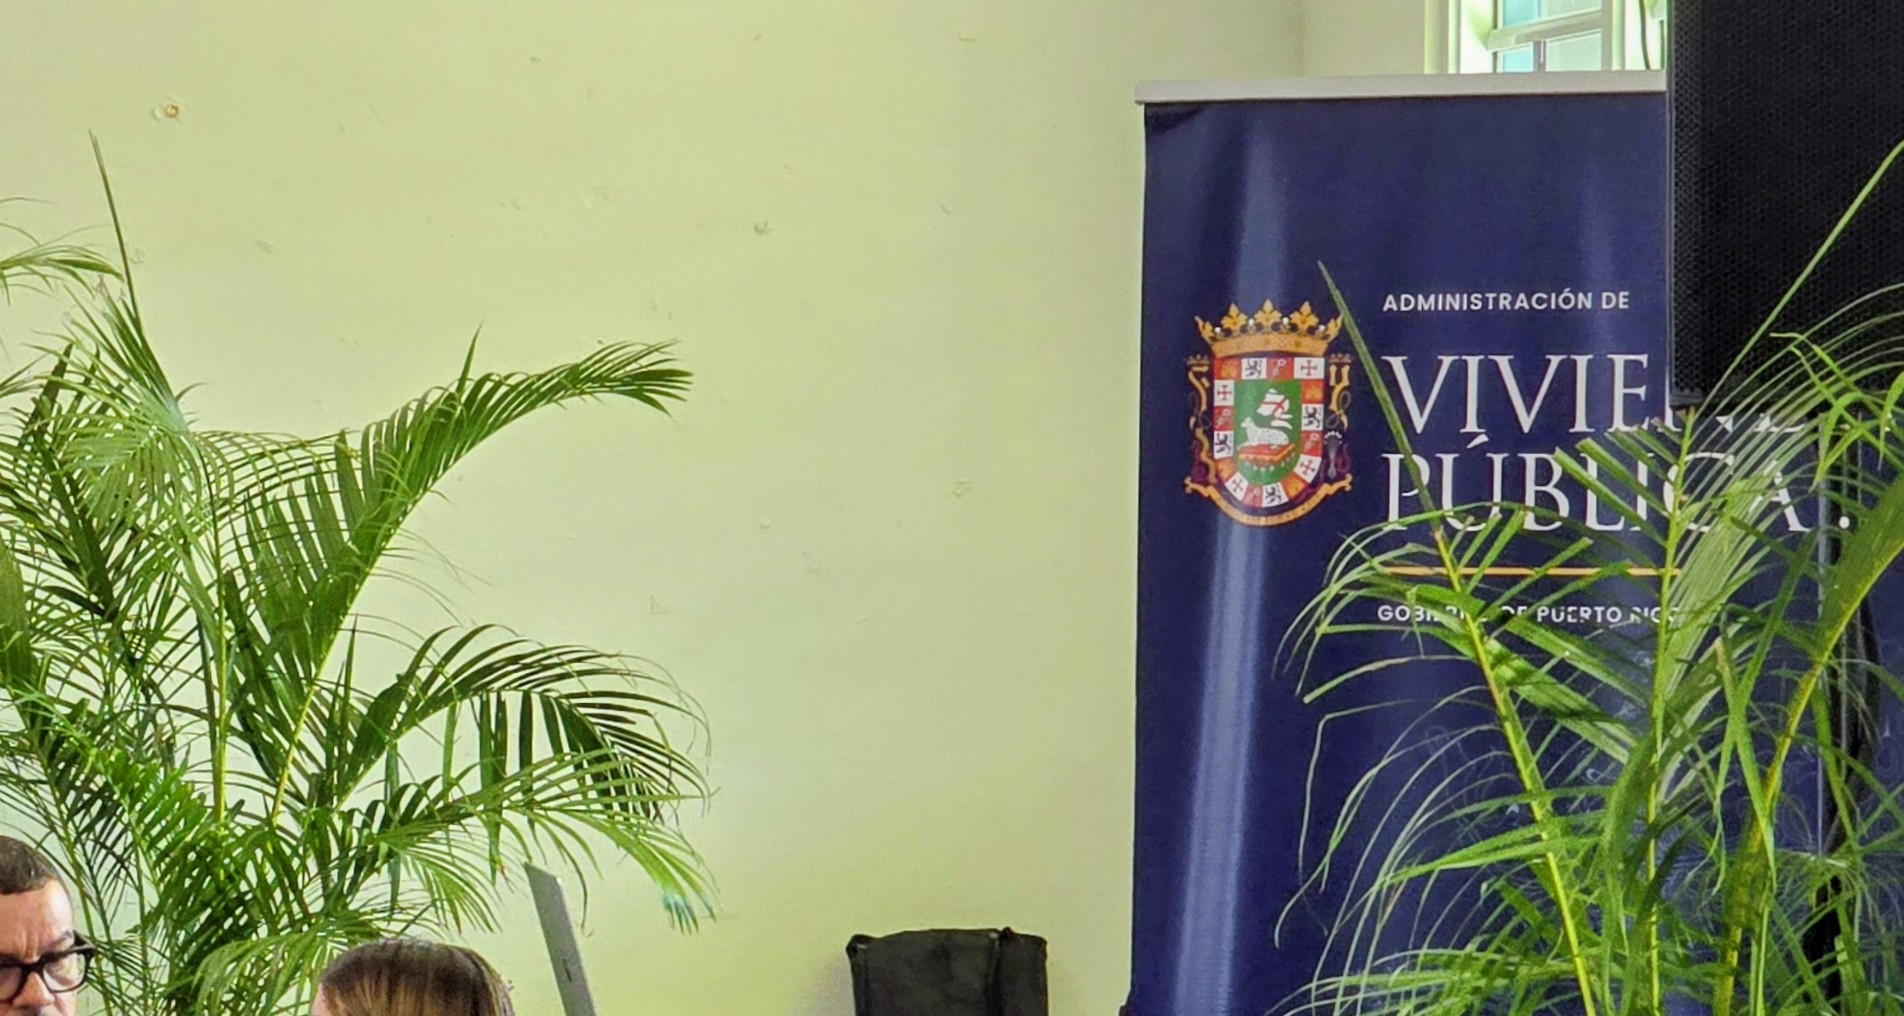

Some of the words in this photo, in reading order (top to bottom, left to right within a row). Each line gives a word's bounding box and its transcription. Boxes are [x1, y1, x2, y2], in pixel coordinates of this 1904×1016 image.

[1382, 287, 1593, 312] ADMINISTRACIÓN
[1601, 291, 1630, 310] DE
[1381, 354, 1841, 434] VIVIE
[1537, 605, 1622, 623] PUERTO
